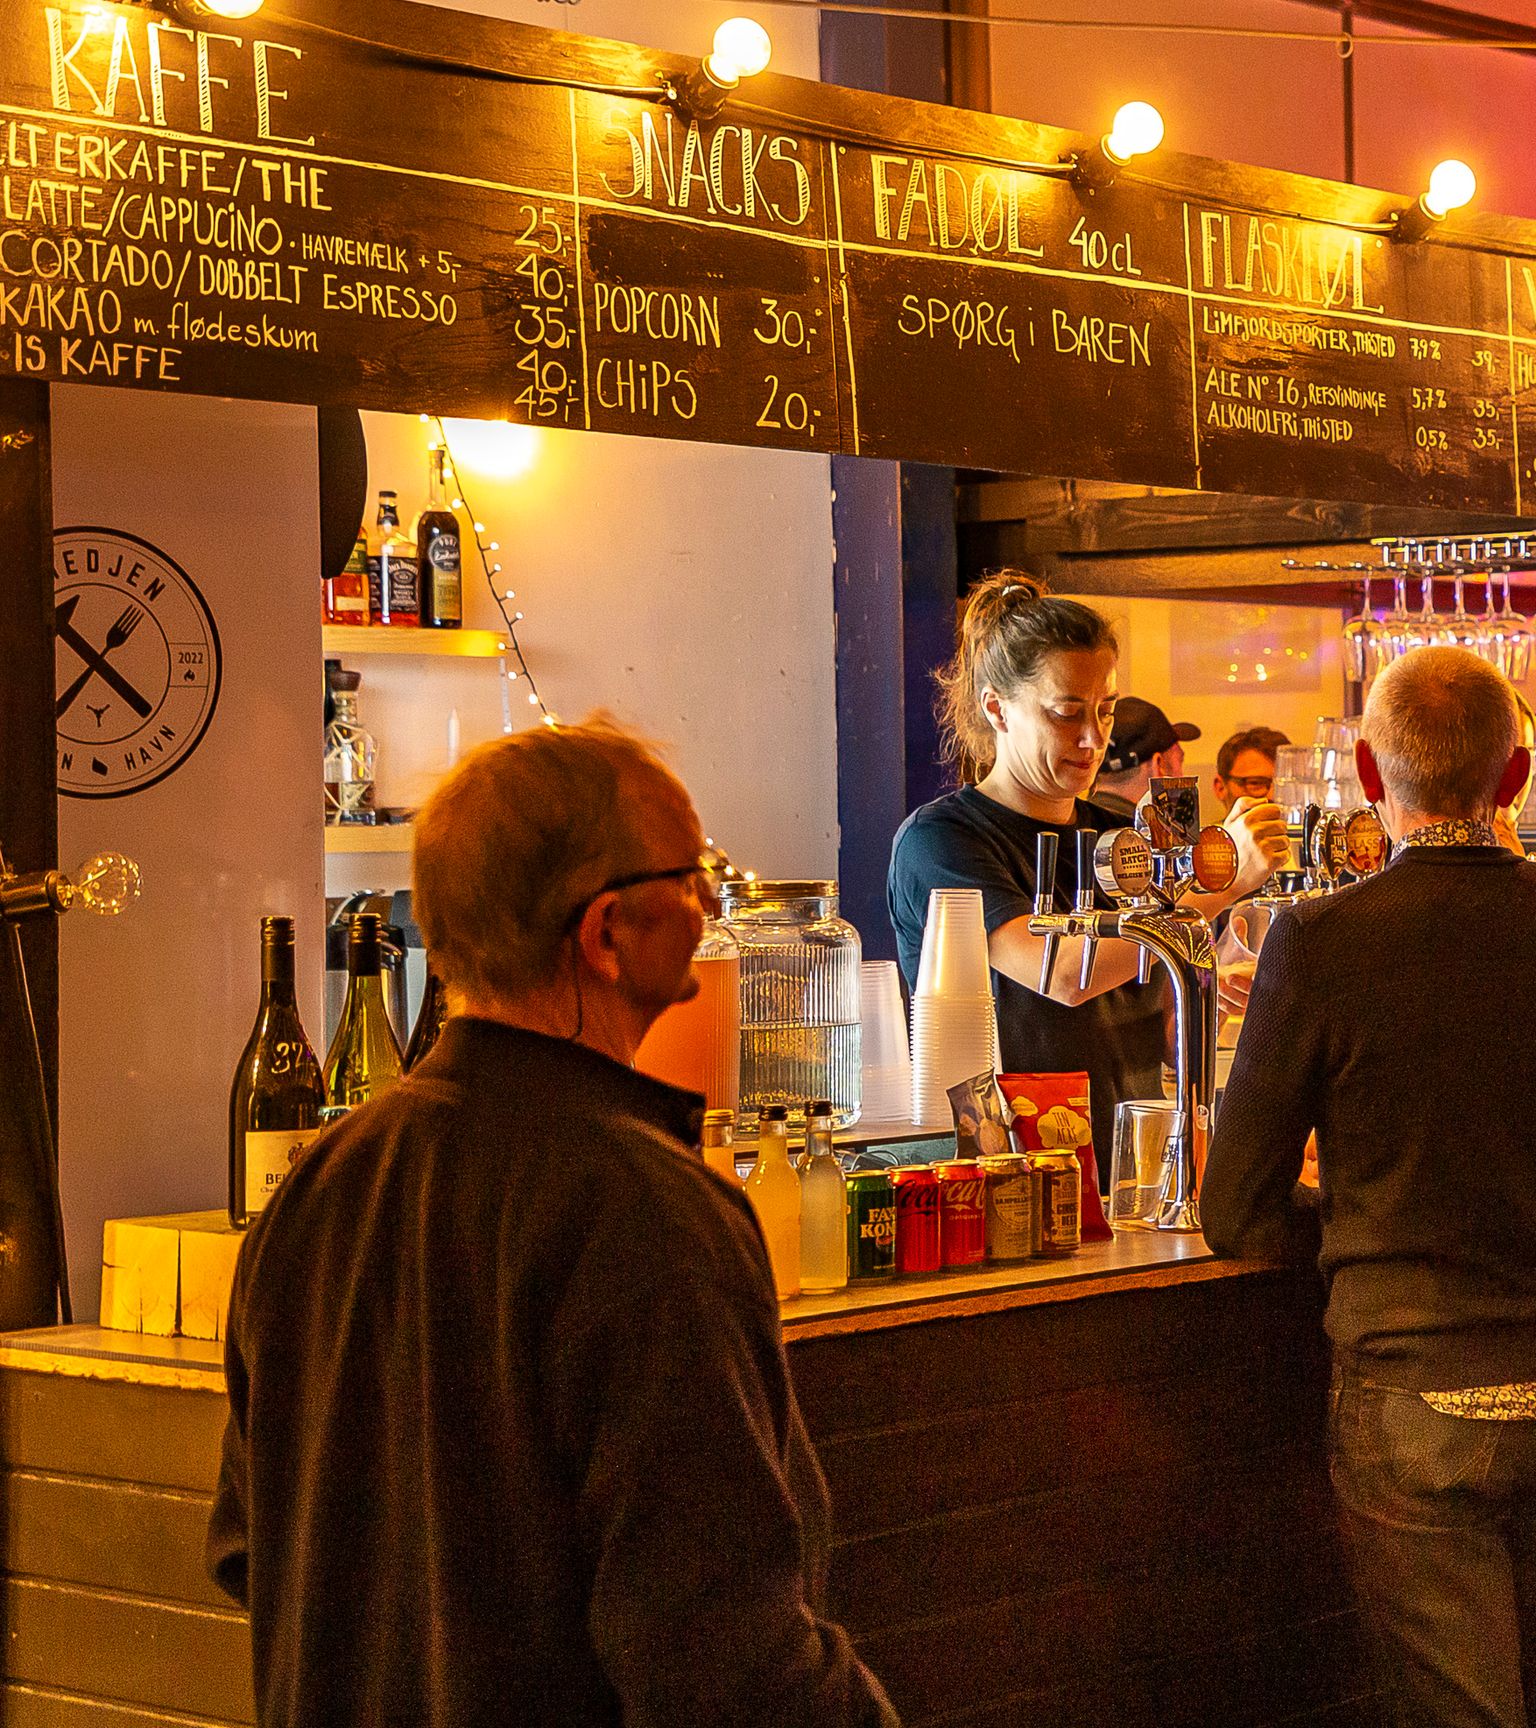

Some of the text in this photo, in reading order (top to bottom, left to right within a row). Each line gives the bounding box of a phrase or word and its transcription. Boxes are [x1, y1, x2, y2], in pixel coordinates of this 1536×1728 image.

[45, 8, 315, 146] KAFFE
[0, 118, 332, 211] LTERKAFFE/THE
[600, 107, 810, 226] SNACKS
[870, 154, 1044, 257] FADØL
[302, 234, 409, 274] HAVREMÆLK
[200, 255, 308, 305] DOBBELT
[323, 274, 457, 326] ESPRESSO
[595, 283, 720, 349] POPCORN
[0, 283, 121, 335] KAKAO
[167, 303, 319, 352] flødeskum
[898, 294, 1021, 364] SPØRG
[1052, 309, 1151, 367] BAREN
[15, 335, 46, 373] IS
[61, 338, 182, 381] KAFFE
[1204, 367, 1241, 398] ALE
[54, 549, 166, 602] EDJEN
[178, 652, 204, 665] 2022
[124, 724, 176, 772] HAVN
[1119, 845, 1147, 857] SMALL
[1121, 854, 1149, 865] BATCH
[860, 1223, 897, 1239] KON
